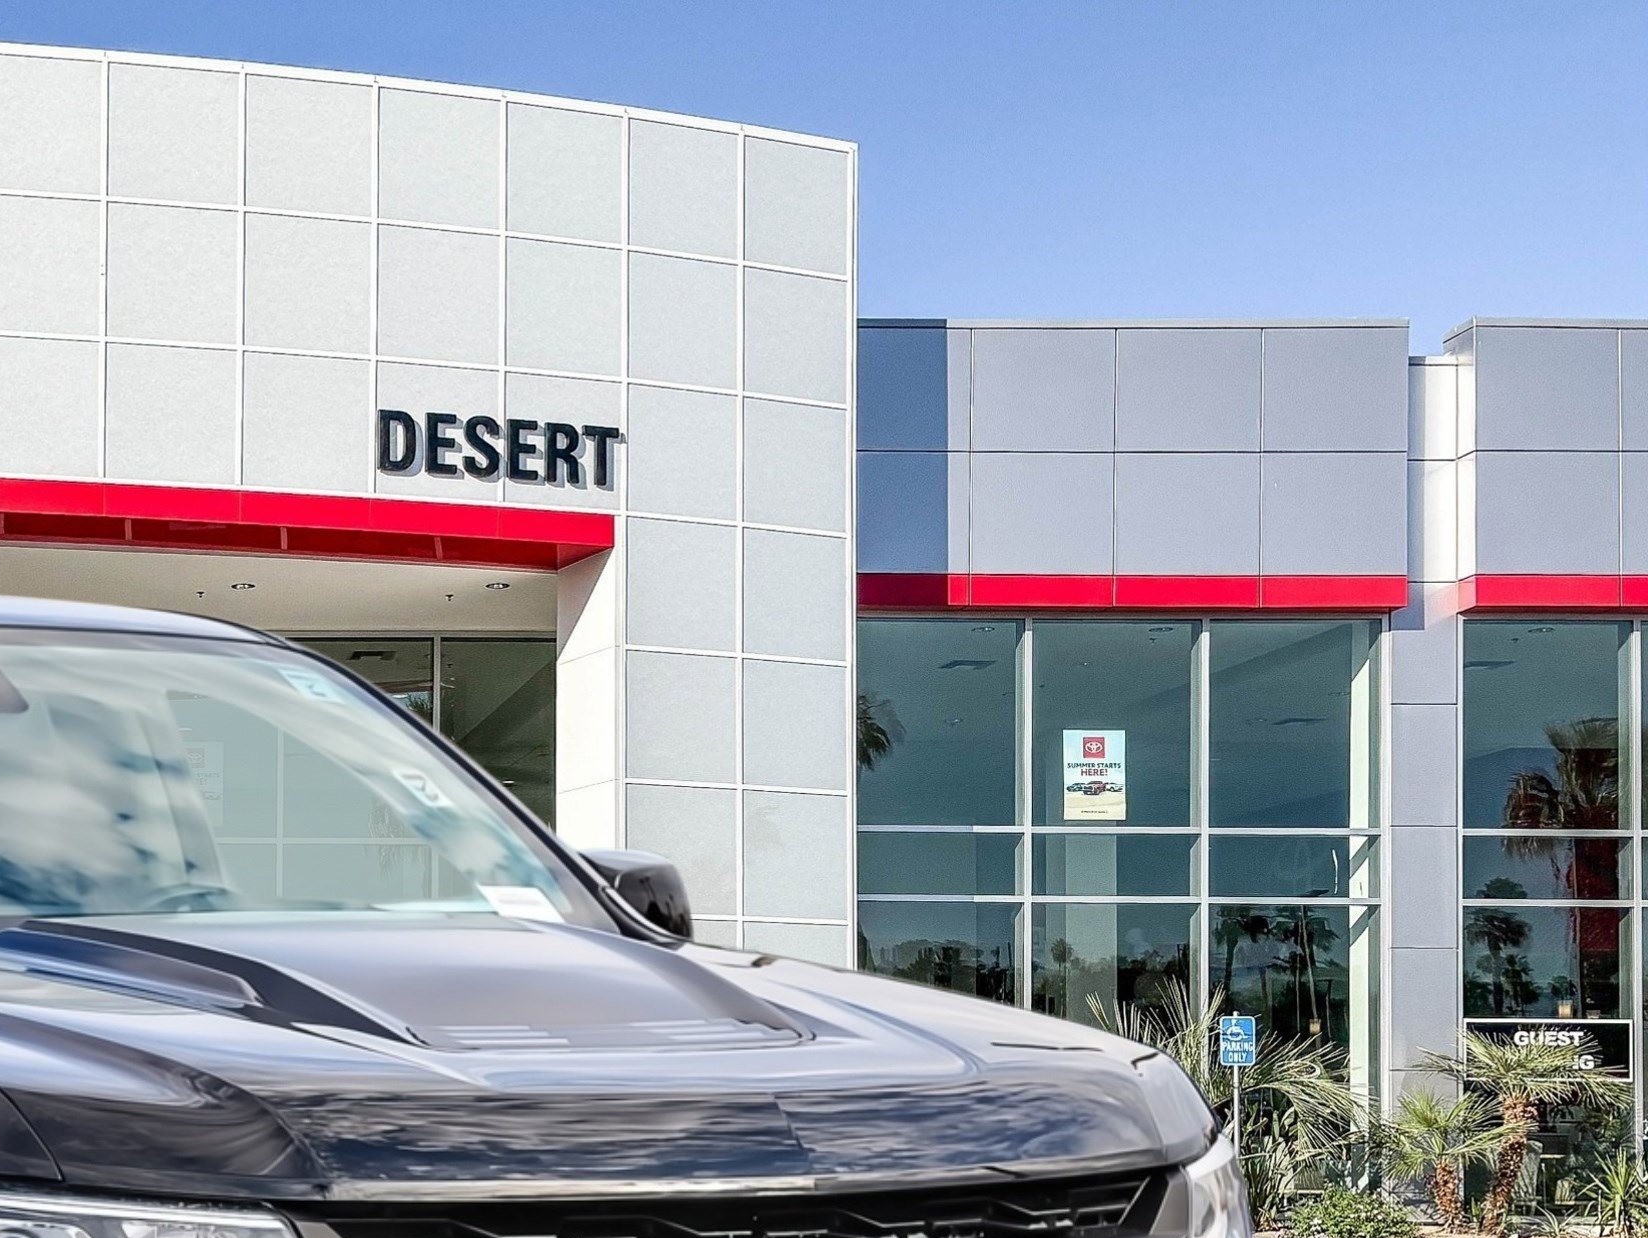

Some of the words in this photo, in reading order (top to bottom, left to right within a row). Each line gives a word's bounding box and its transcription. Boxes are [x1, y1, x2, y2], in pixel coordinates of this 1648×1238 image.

[377, 409, 620, 486] DESERT
[1080, 768, 1108, 777] HERE!
[1513, 1030, 1585, 1047] GUEST
[1222, 1041, 1254, 1051] PARKING
[1228, 1052, 1247, 1062] ONLY
